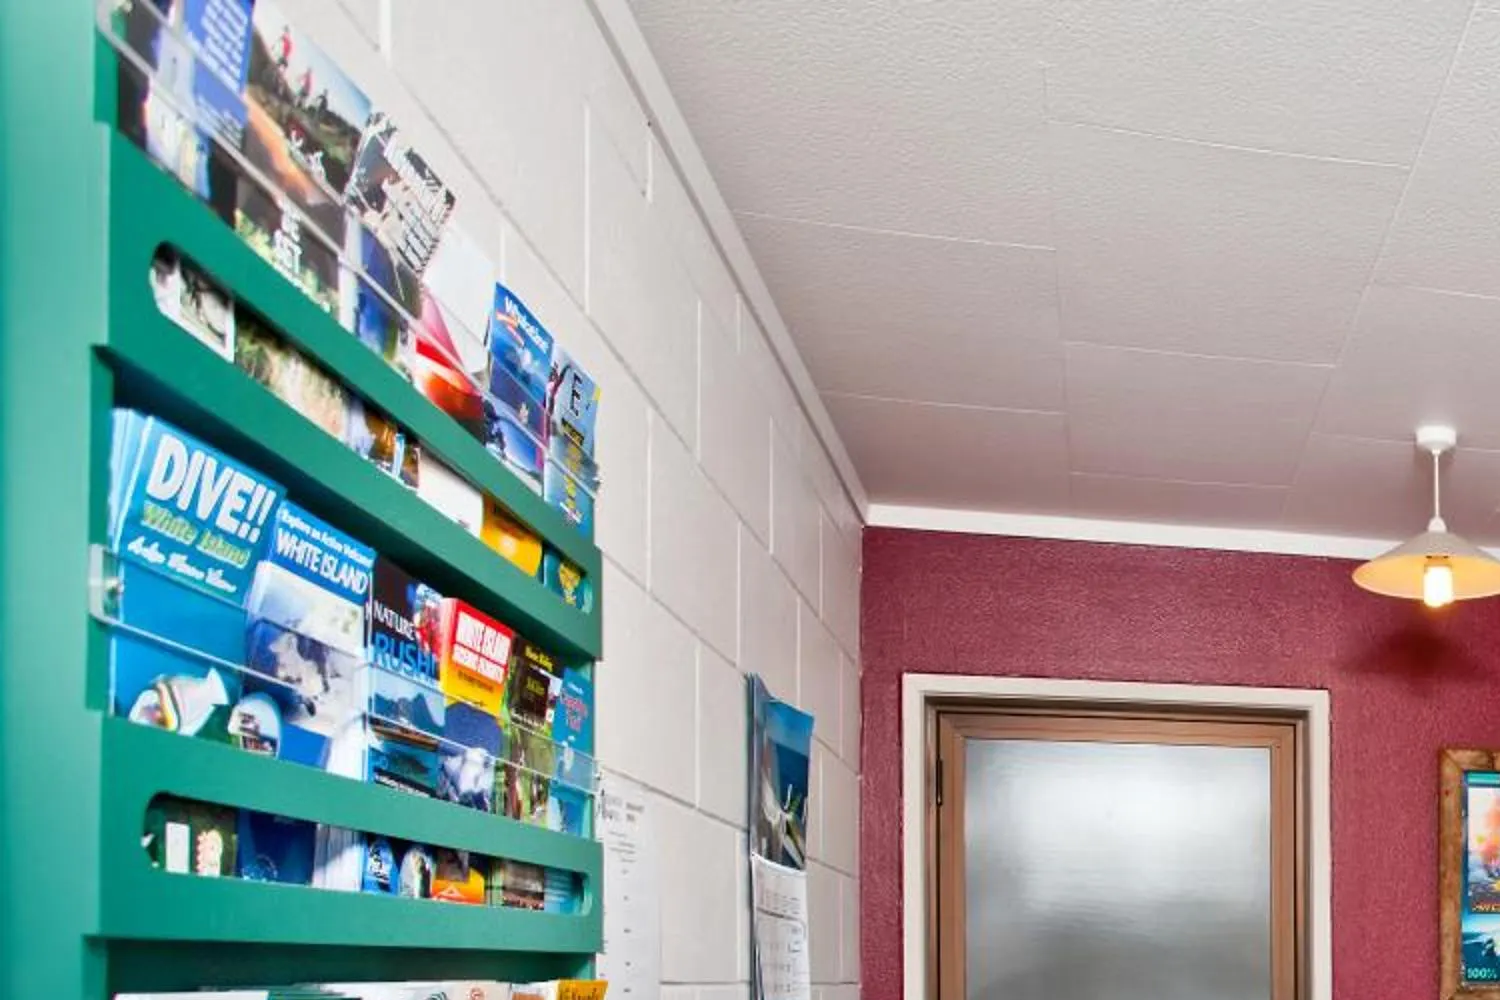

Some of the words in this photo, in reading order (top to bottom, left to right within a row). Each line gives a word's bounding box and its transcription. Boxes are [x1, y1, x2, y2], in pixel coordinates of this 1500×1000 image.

[146, 434, 277, 543] DIVE!!
[277, 528, 322, 571] WHITE
[319, 549, 369, 595] ISLAND
[1467, 967, 1498, 980] 100%
